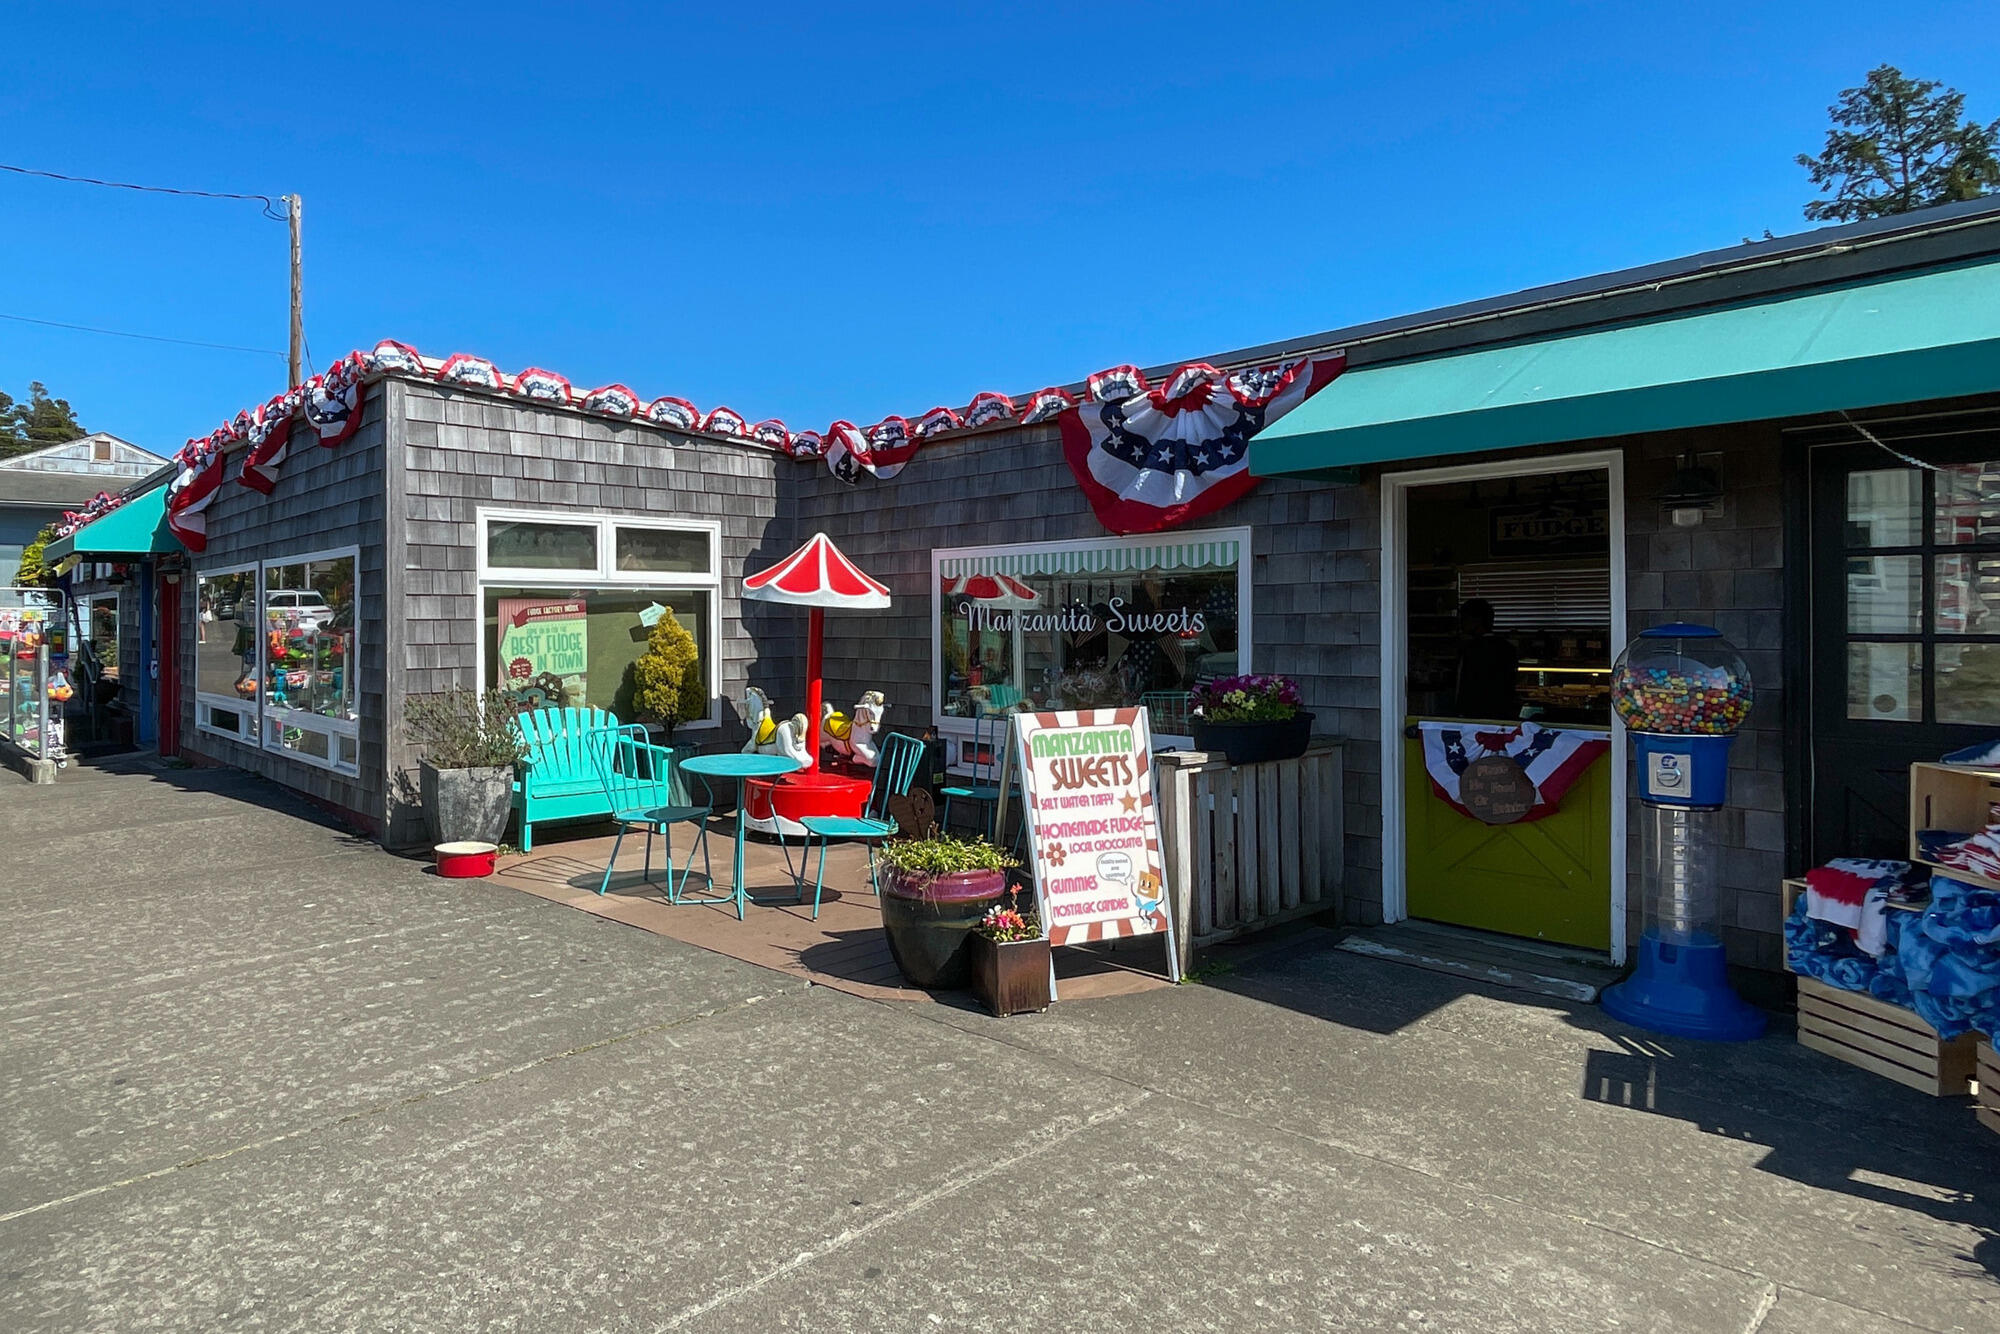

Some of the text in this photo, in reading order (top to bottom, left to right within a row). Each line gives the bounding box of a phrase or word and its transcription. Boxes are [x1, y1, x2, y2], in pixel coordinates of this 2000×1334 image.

[1504, 516, 1604, 538] FUDGE
[958, 597, 1205, 633] Manzanita Sweets
[511, 632, 583, 656] BEST FUDGE
[537, 653, 547, 671] IN
[551, 650, 583, 670] TOWN
[1032, 728, 1133, 758] MANZANITA
[1050, 754, 1133, 791] SWEETS
[1040, 792, 1114, 811] SALT WATER TAFFY
[1042, 815, 1144, 840] HOMEMADE FUDGE
[1069, 836, 1143, 854] LOCAL CHOCOLATES
[1050, 875, 1098, 894] GUMMIES
[1053, 897, 1129, 918] NOSTALGIC CANDIES
